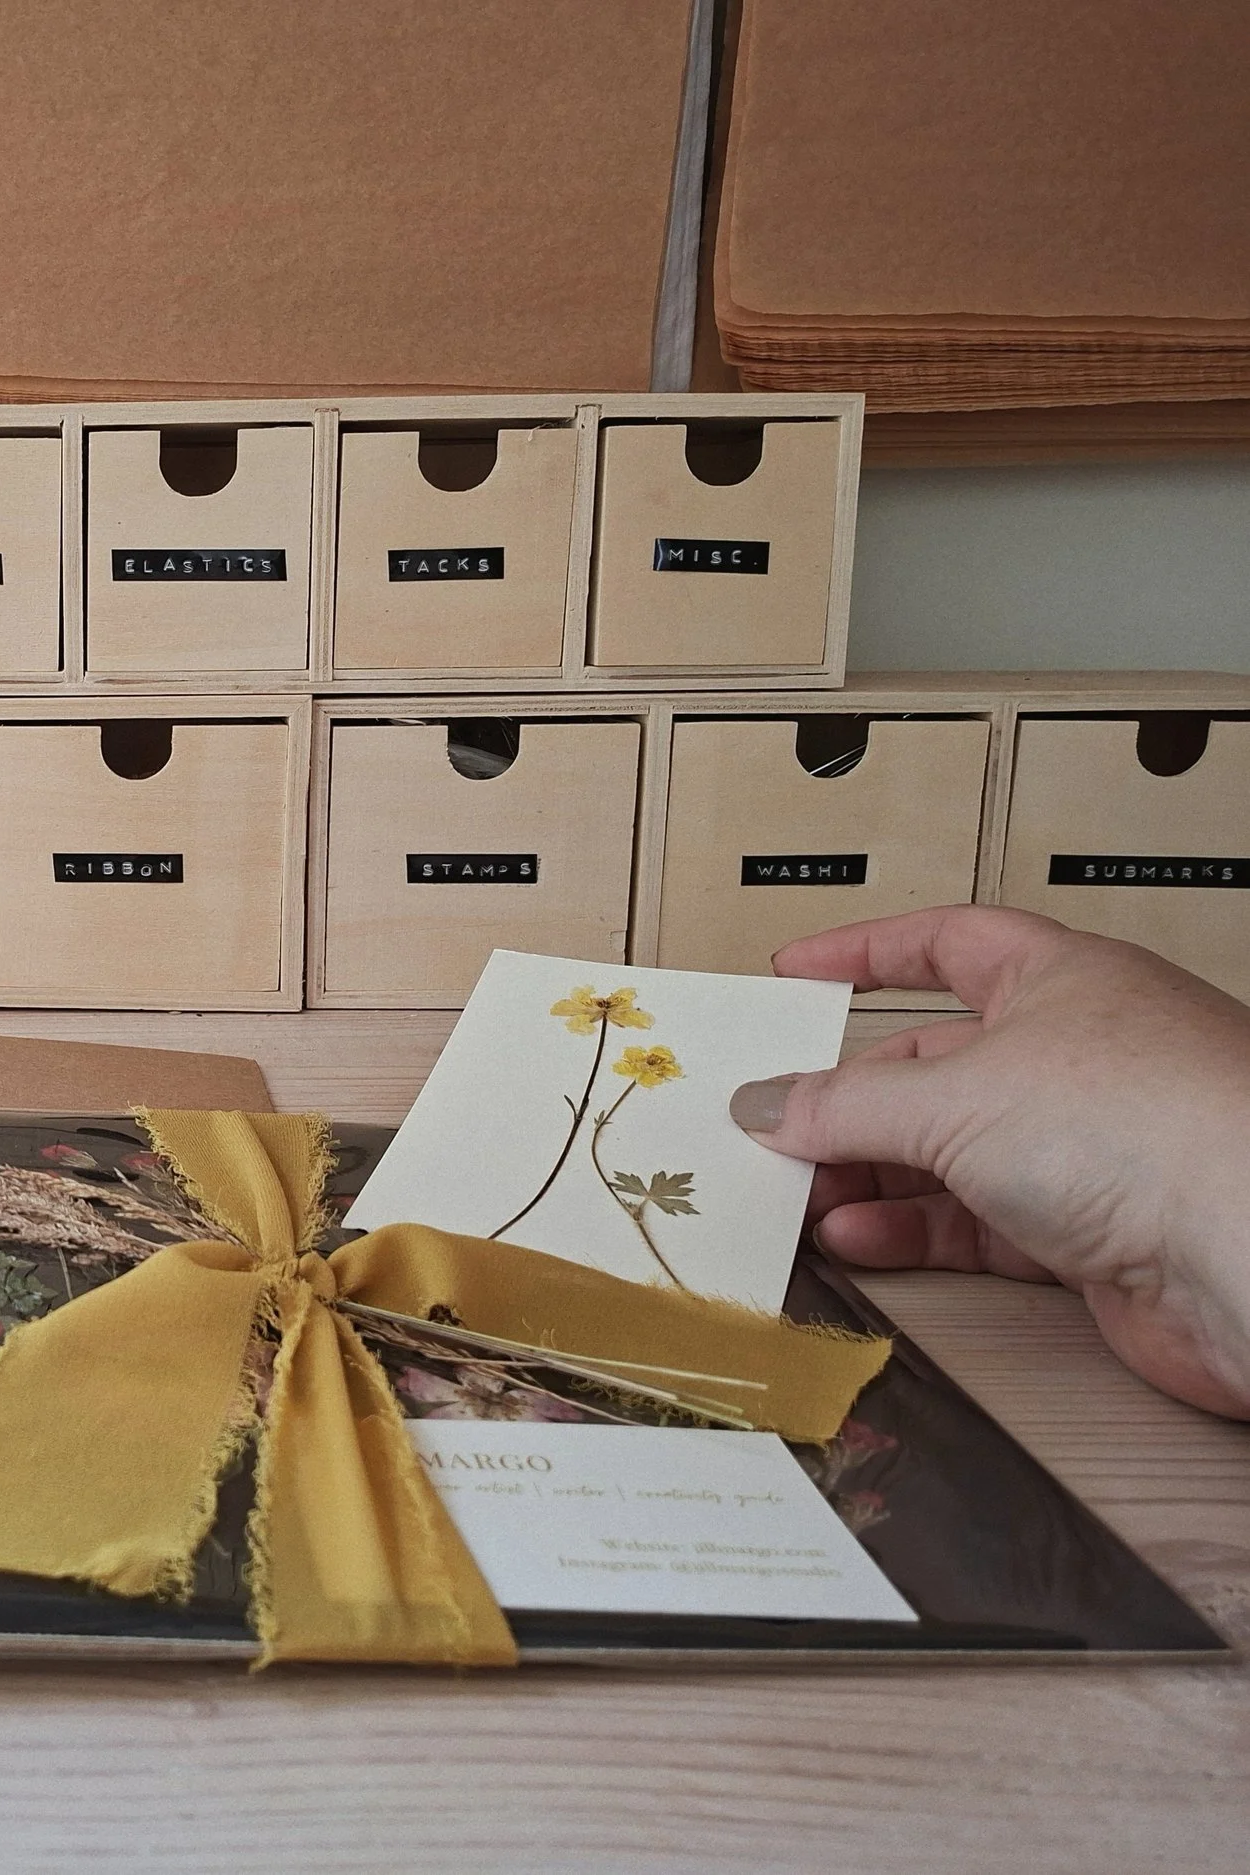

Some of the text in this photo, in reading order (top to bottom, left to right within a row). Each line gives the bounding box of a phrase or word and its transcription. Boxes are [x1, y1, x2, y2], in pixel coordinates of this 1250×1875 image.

[123, 556, 272, 574] ELASTICS
[397, 557, 491, 575] TACKS
[667, 548, 759, 566] MISC.
[64, 860, 173, 877] RIBBON
[422, 862, 532, 878] STAMPS
[756, 864, 849, 879] WASHI
[1083, 863, 1236, 881] SUBMARKS
[415, 1451, 553, 1473] MARGO
